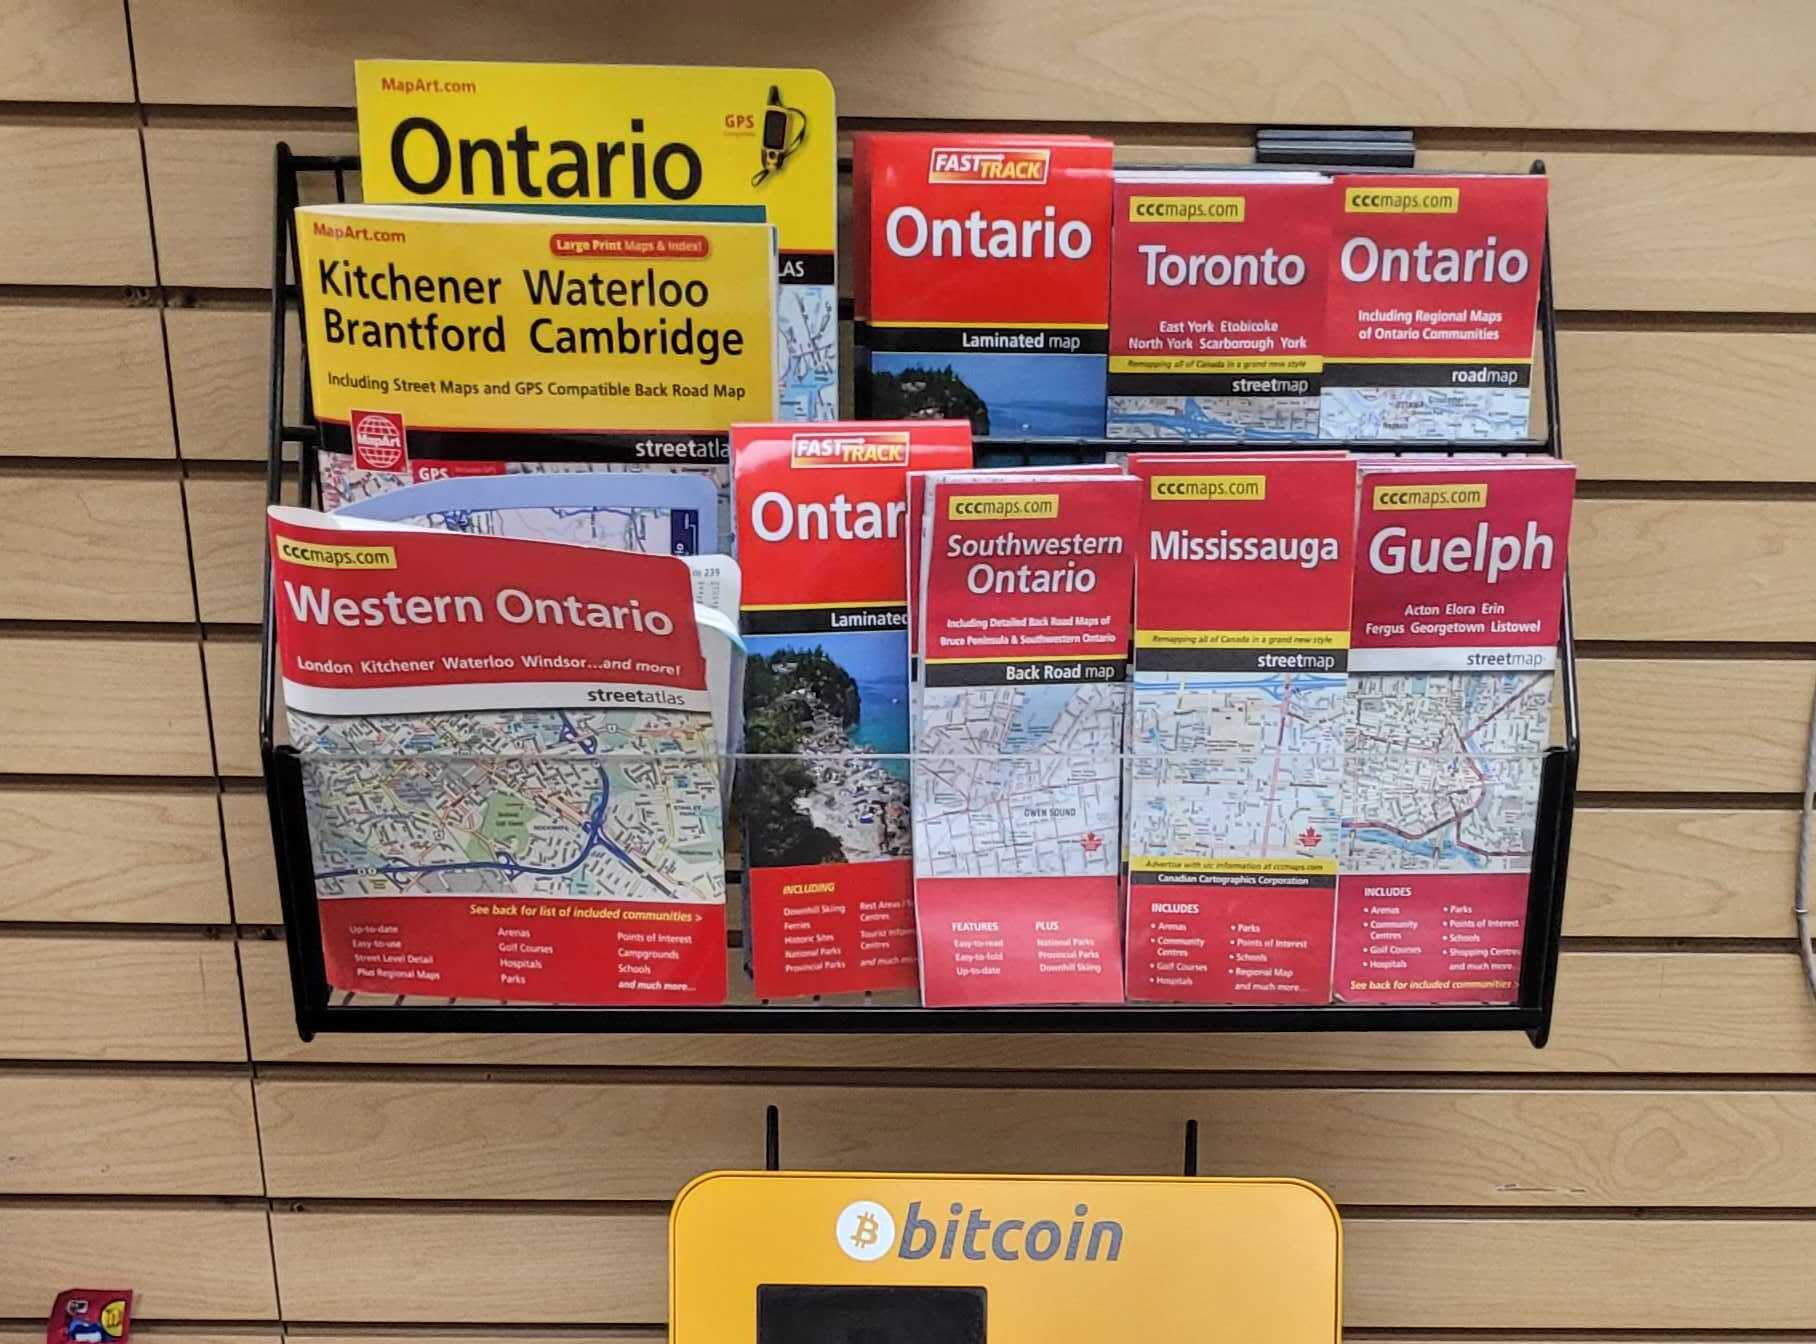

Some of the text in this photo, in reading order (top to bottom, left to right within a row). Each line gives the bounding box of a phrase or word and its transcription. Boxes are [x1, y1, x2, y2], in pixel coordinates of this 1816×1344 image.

[381, 77, 476, 95] MapArt.com
[725, 115, 754, 129] GPS
[390, 116, 702, 200] Ontario
[935, 154, 1042, 179] FAST TRACK
[1136, 203, 1239, 220] cccmaps.com
[1352, 193, 1452, 211] cccmaps.com
[886, 206, 1092, 259] Ontario
[1138, 245, 1306, 286] Toronto
[1340, 236, 1528, 283] Ontario
[318, 259, 709, 308] Kitchener Waterloo
[324, 308, 744, 365] Brantford Cambridge
[1160, 320, 1278, 333] East York Etobicoke
[962, 332, 1080, 352] Laminated map
[1129, 337, 1307, 352] North York Scarborough York
[328, 372, 745, 400] Including Street Maps and GPS Compatible Back Road Map
[1452, 368, 1518, 385] roadmap
[1232, 379, 1308, 398] streetmap
[636, 439, 730, 458] streetatla
[798, 439, 903, 461] FAST TRACK
[1158, 481, 1259, 498] cccmaps.com
[1379, 489, 1480, 507] cccmaps.com
[752, 491, 907, 541] Ontar
[956, 500, 1052, 516] cccmaps.com
[948, 532, 1122, 557] Southwestern
[1150, 530, 1339, 569] Mississauga
[1369, 521, 1554, 584] Guelph
[283, 543, 389, 567] cccmaps.com
[967, 561, 1096, 594] Ontario
[283, 580, 674, 636] Western Ontario
[1405, 603, 1505, 616] Acton Elora Erin
[1366, 621, 1540, 636] Fergus Georgetown Listowel
[297, 656, 353, 675] London
[361, 659, 435, 673] Kitchener
[442, 657, 514, 669] Waterloo
[635, 662, 680, 676] more!
[1258, 654, 1335, 670] streetmap
[1467, 653, 1543, 667] streetmap
[1006, 665, 1115, 681] Back Road map
[588, 688, 685, 705] streetatlas
[898, 1201, 1123, 1262] bitcoin
